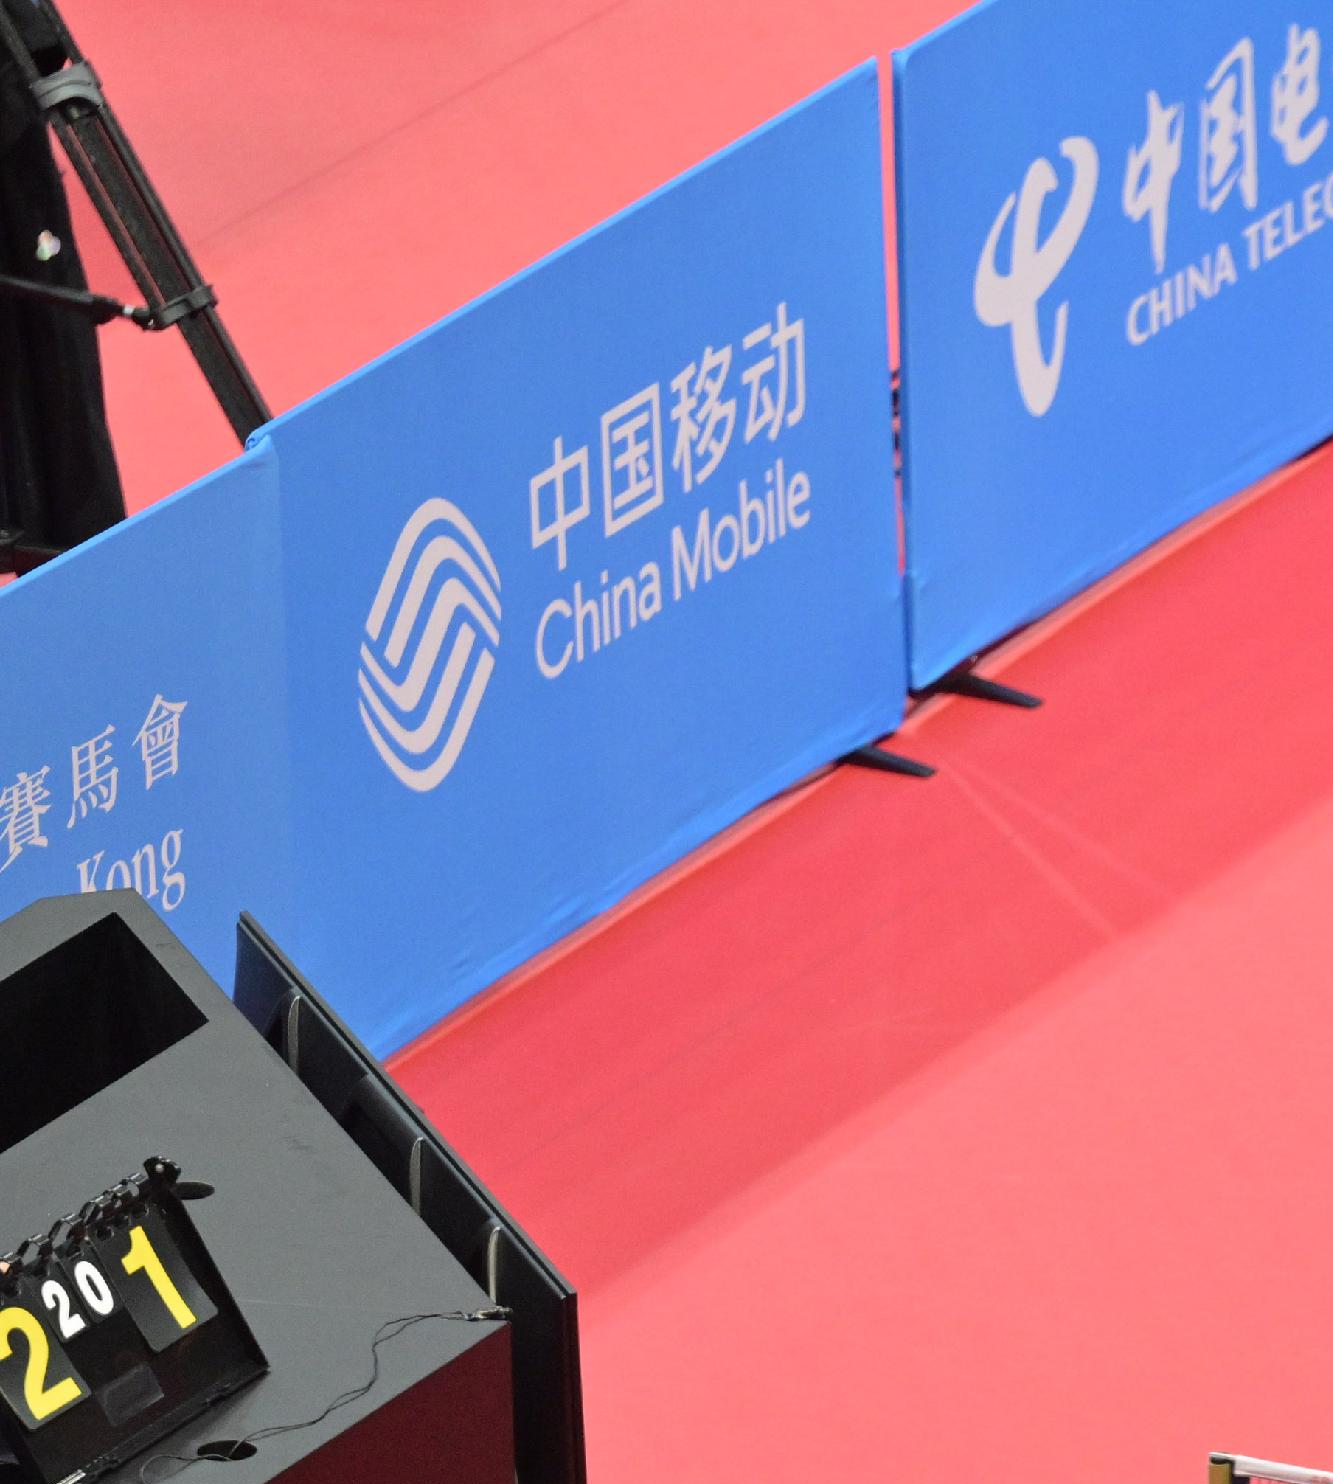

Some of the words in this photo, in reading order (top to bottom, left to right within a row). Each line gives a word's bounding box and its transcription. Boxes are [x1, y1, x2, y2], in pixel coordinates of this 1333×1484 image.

[1126, 242, 1238, 346] CHINA
[529, 301, 807, 571] 中国移动
[535, 562, 663, 680] China
[671, 457, 811, 602] Mobile
[0, 694, 188, 873] 賽馬會
[76, 828, 186, 912] Kong
[0, 1307, 82, 1421] 2
[121, 1226, 198, 1330] 1
